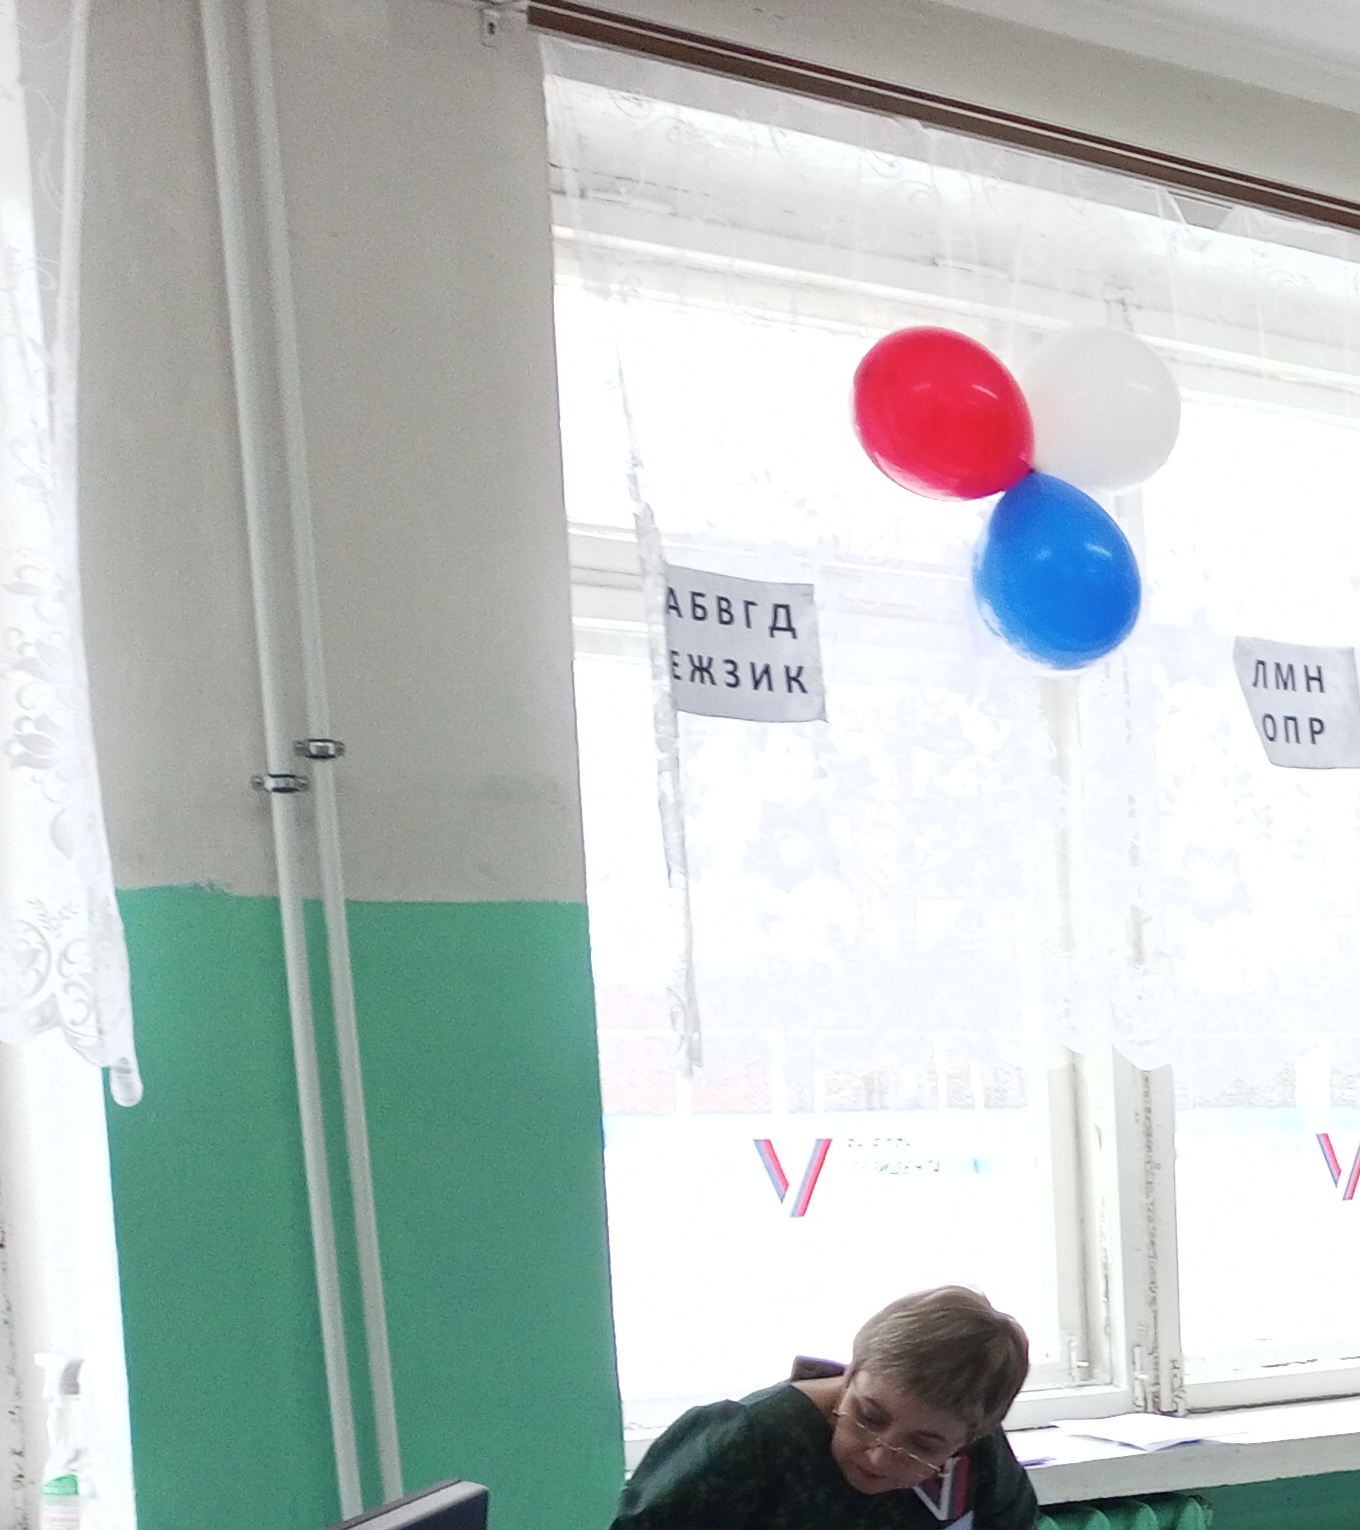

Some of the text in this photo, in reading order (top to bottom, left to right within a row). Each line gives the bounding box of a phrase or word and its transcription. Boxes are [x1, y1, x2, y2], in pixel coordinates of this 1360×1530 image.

[666, 586, 797, 639] АБВГД
[669, 650, 809, 693] ЕЖЗИК
[1252, 659, 1325, 693] ЛМН
[1262, 712, 1325, 745] ОПР
